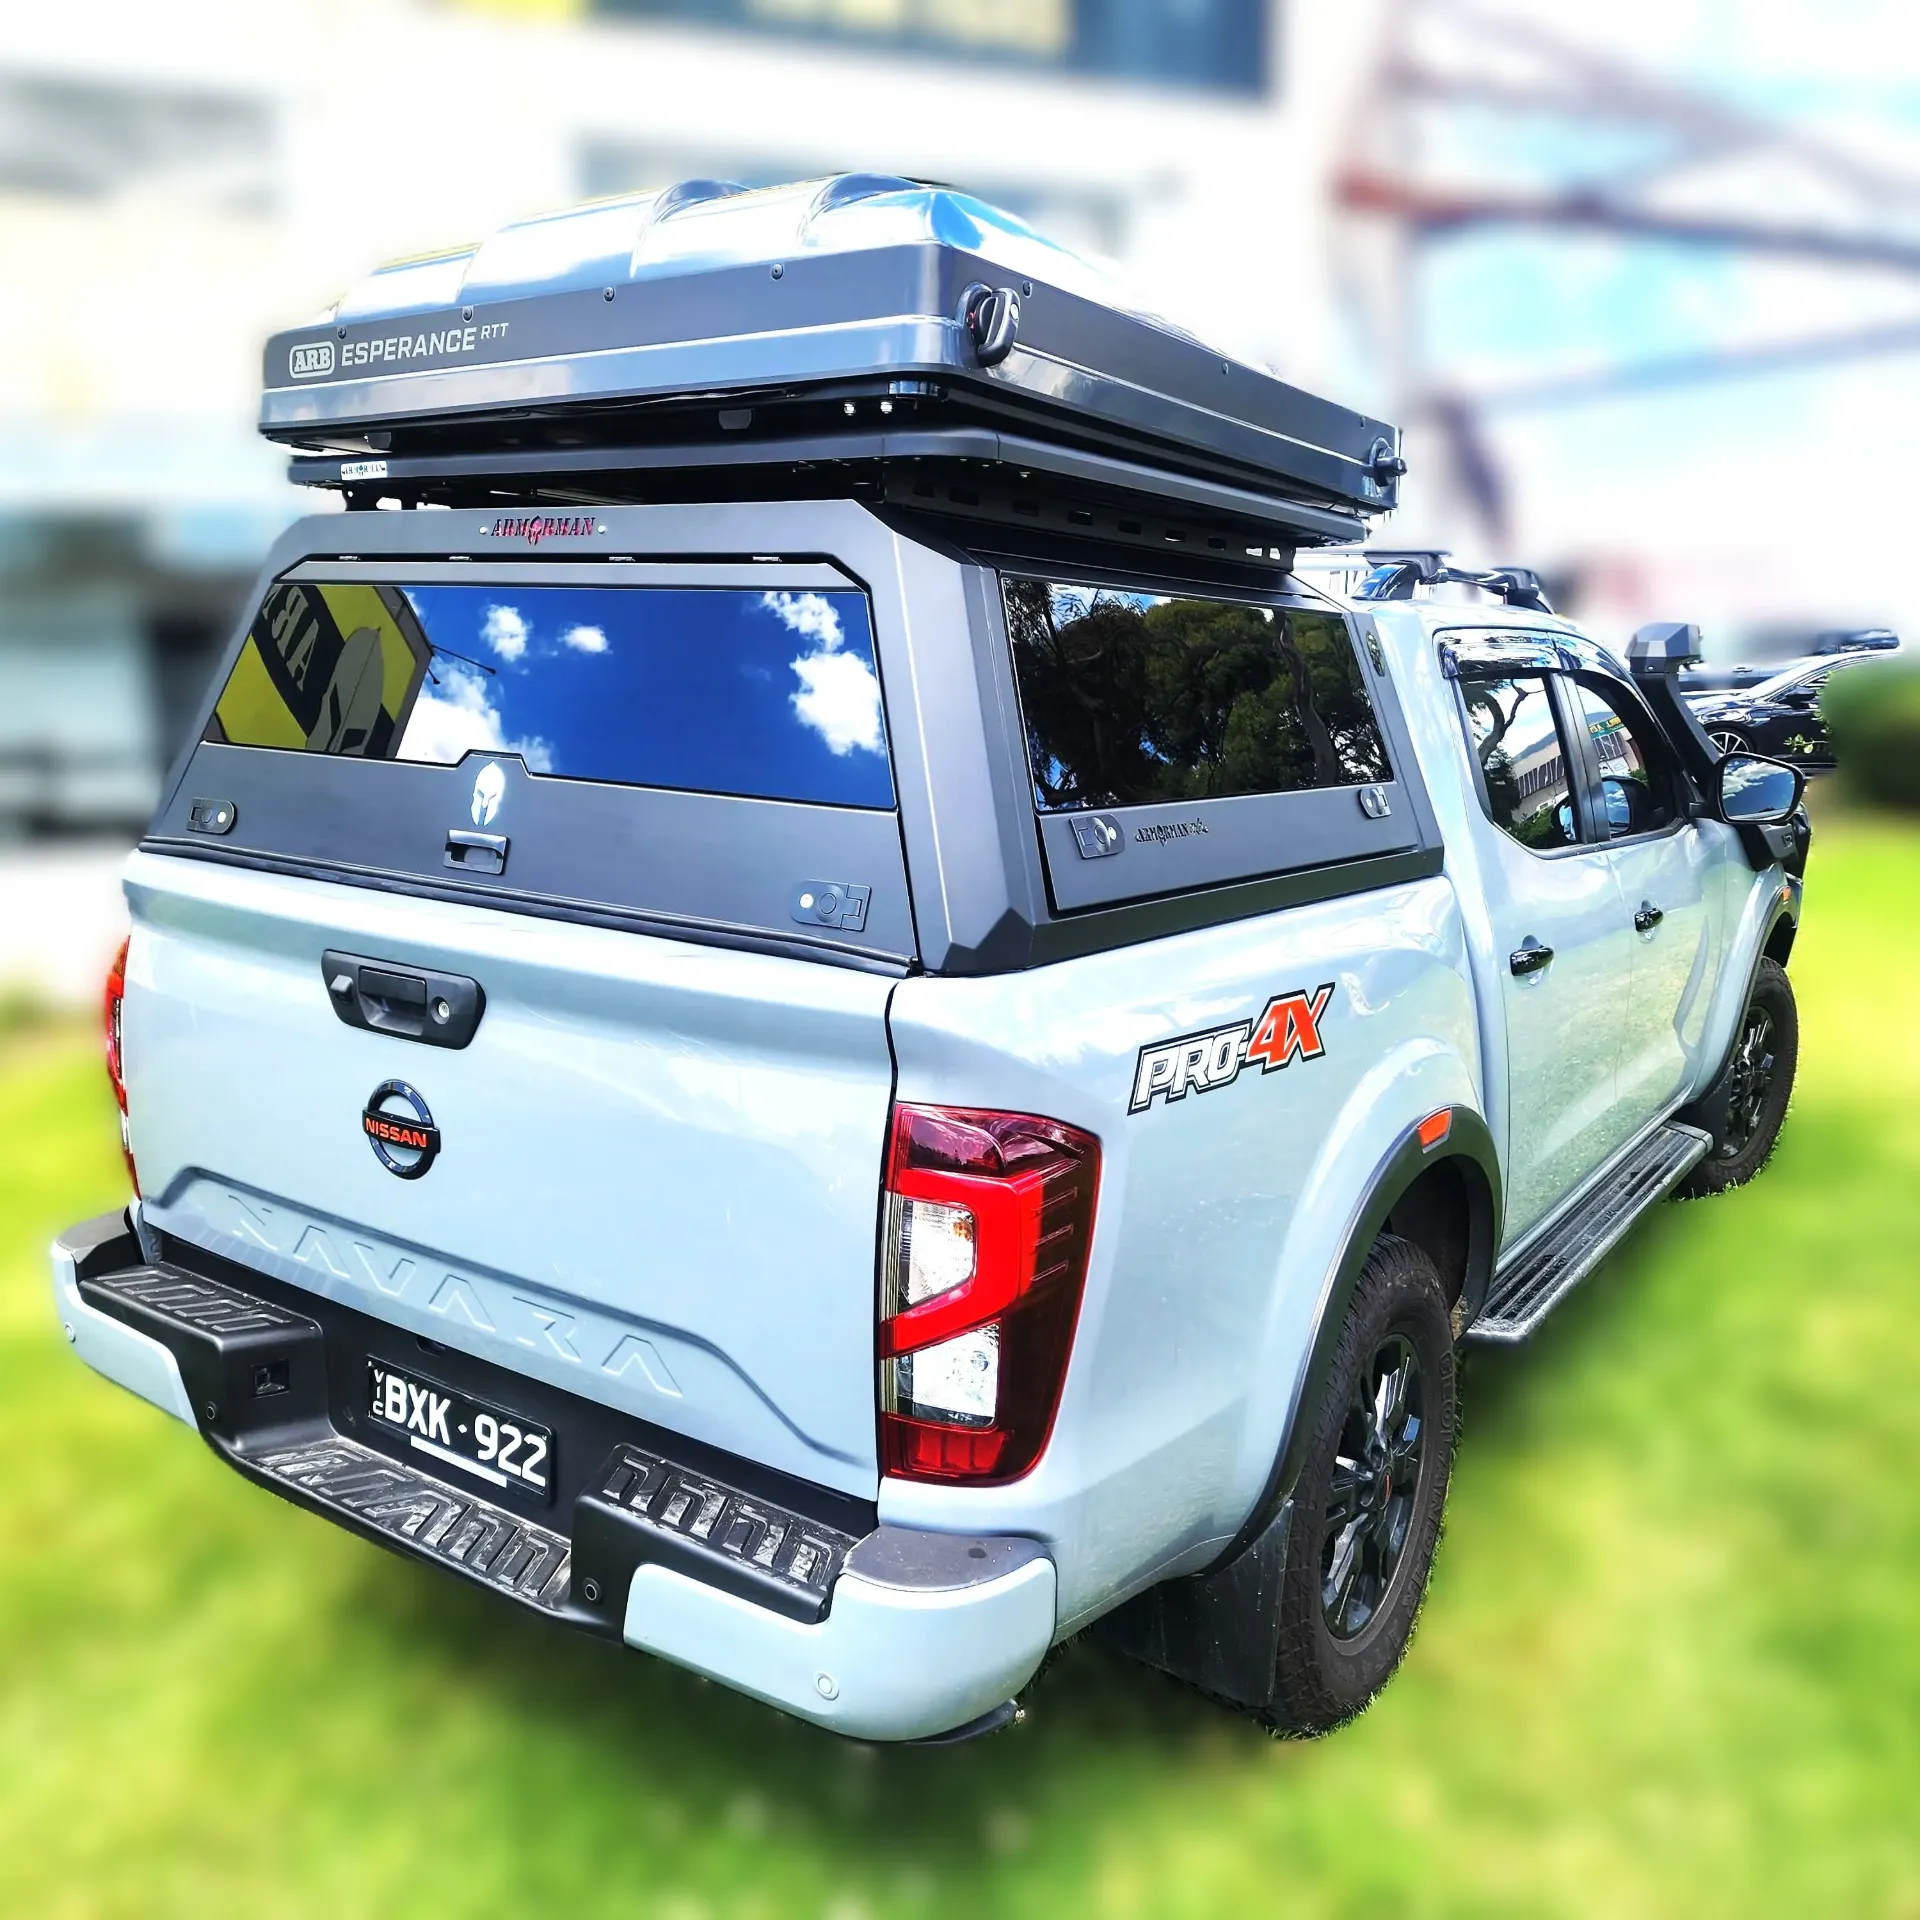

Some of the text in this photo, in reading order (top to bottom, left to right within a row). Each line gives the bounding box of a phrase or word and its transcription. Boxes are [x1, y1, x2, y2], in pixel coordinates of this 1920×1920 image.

[293, 322, 509, 373] ARB ESPERANCE RTT
[1127, 982, 1336, 1116] PRO-4X
[365, 1117, 427, 1148] NISSAN
[228, 1194, 683, 1397] NAVARA
[372, 1369, 385, 1416] VIC
